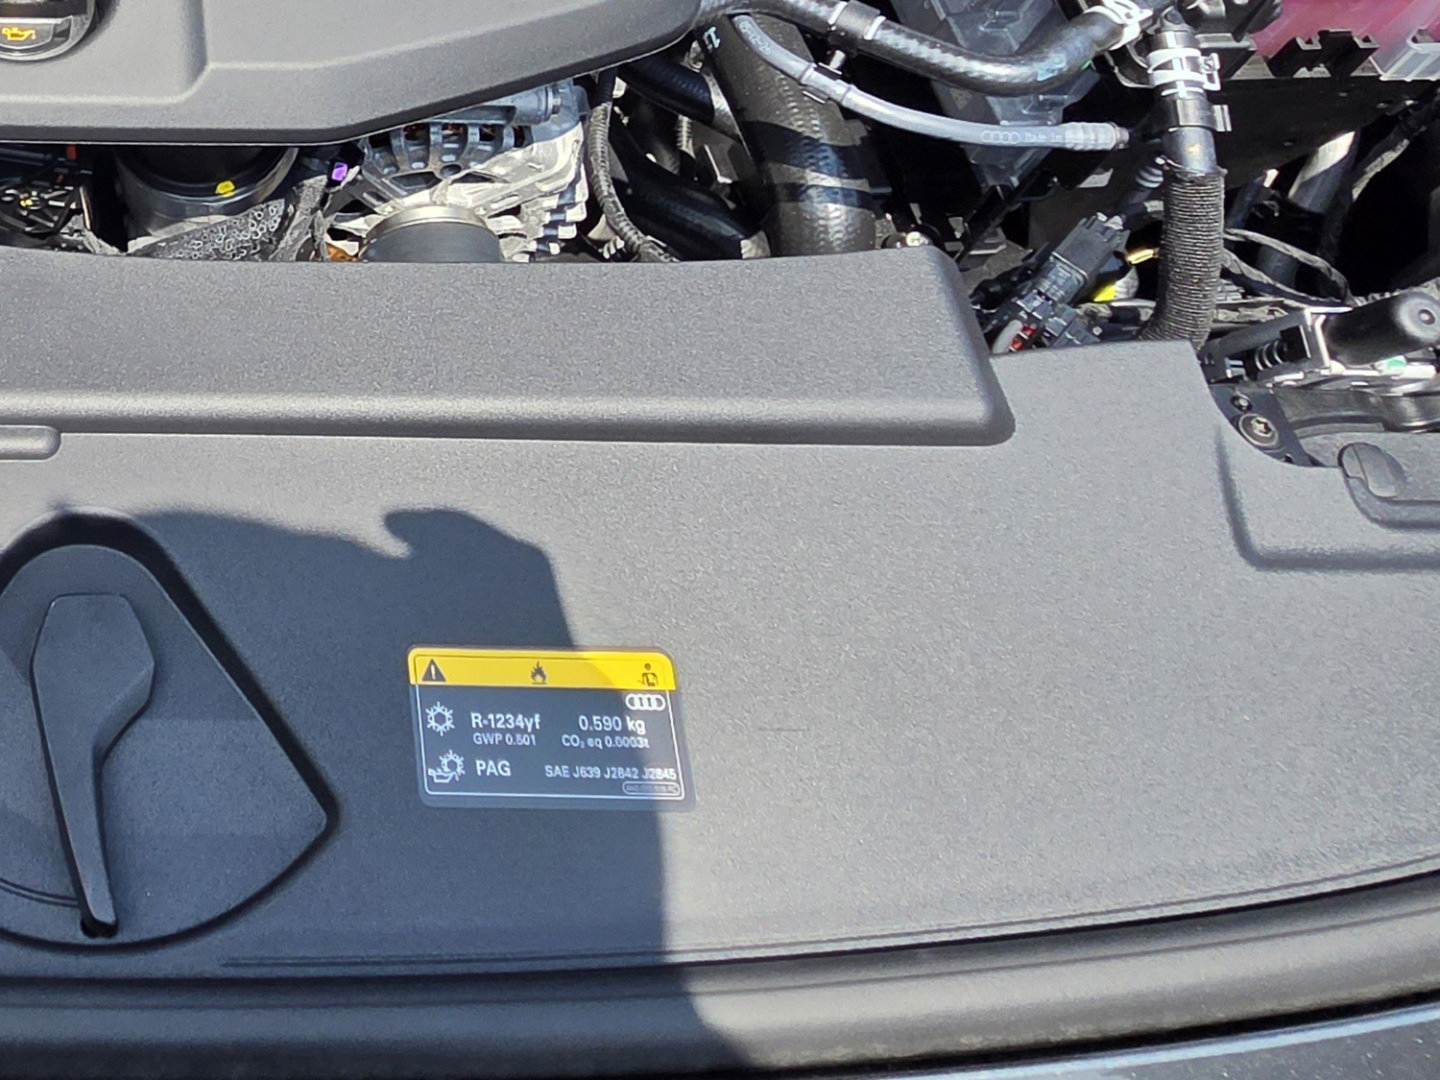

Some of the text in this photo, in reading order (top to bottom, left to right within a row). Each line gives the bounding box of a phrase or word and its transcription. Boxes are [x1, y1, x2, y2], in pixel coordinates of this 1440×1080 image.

[470, 712, 541, 733] R-1234yf
[578, 715, 646, 735] 0.590 kg
[472, 732, 503, 746] GWP
[587, 737, 603, 750] eq
[475, 759, 511, 776] PAG
[544, 765, 570, 778] SAE
[572, 765, 601, 779] J639
[603, 765, 639, 780] J2842
